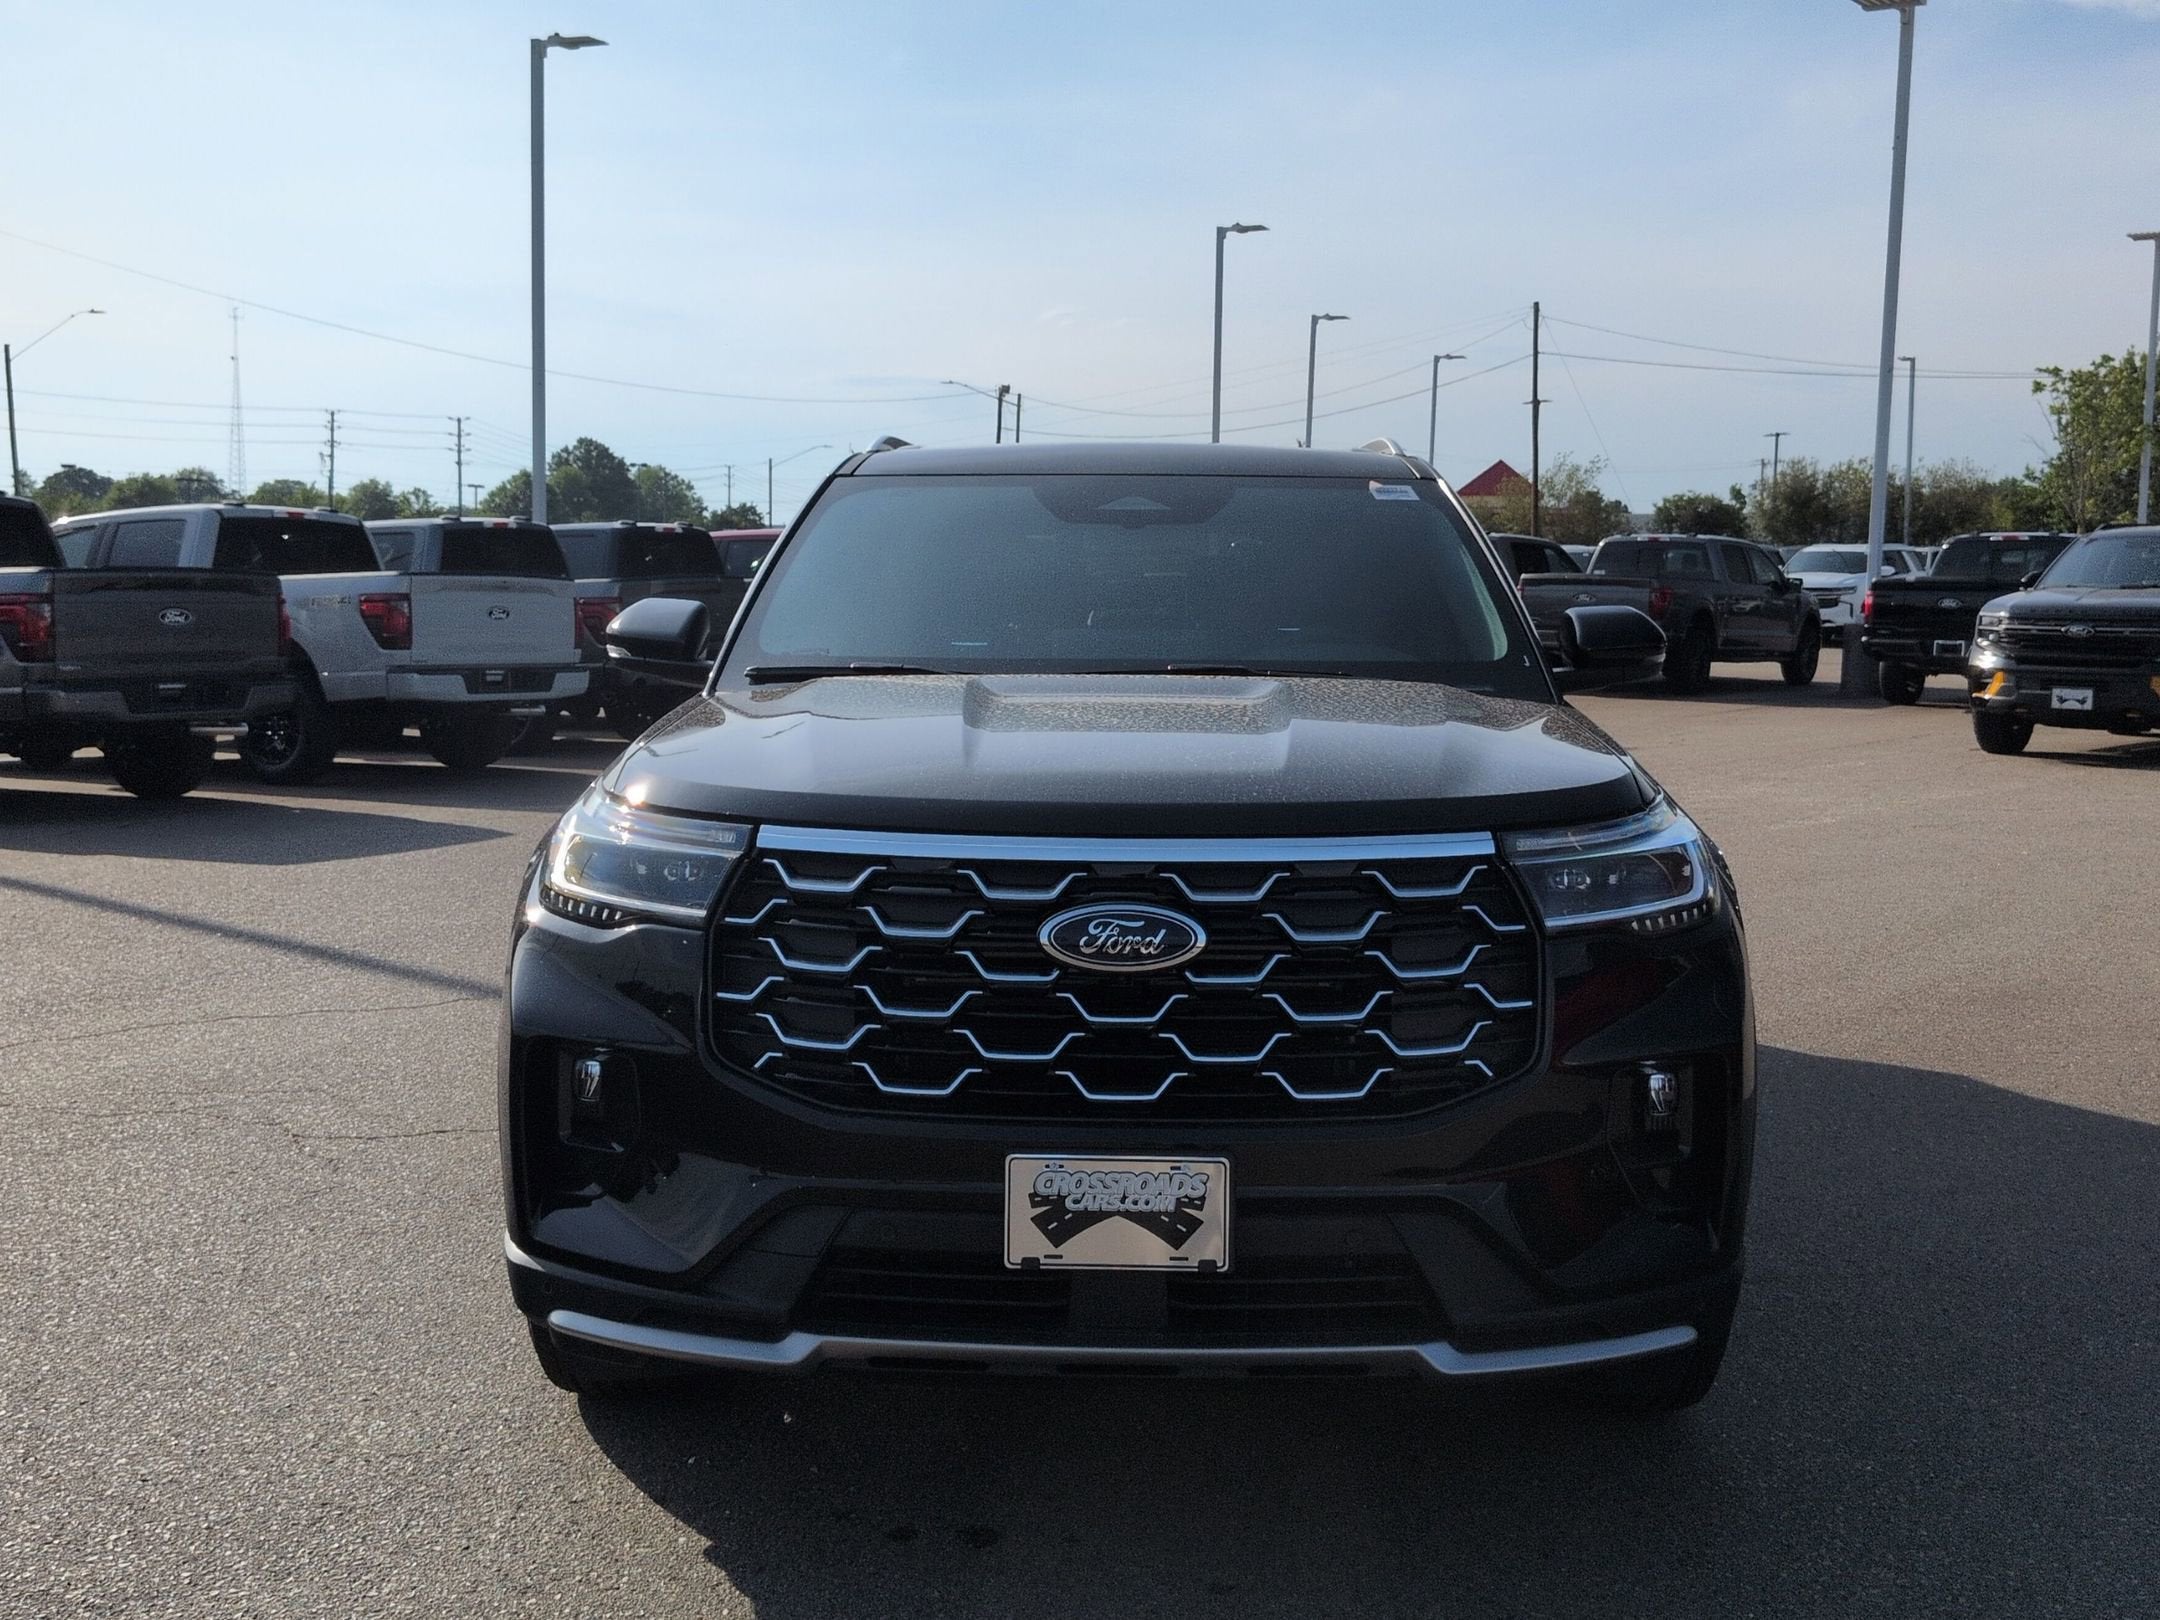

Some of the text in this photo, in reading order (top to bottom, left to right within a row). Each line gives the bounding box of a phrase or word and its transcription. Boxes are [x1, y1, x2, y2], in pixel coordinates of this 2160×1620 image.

[1079, 918, 1167, 955] Ford
[1033, 1170, 1209, 1198] CROSSROADS
[1064, 1193, 1178, 1213] CARS.COM
